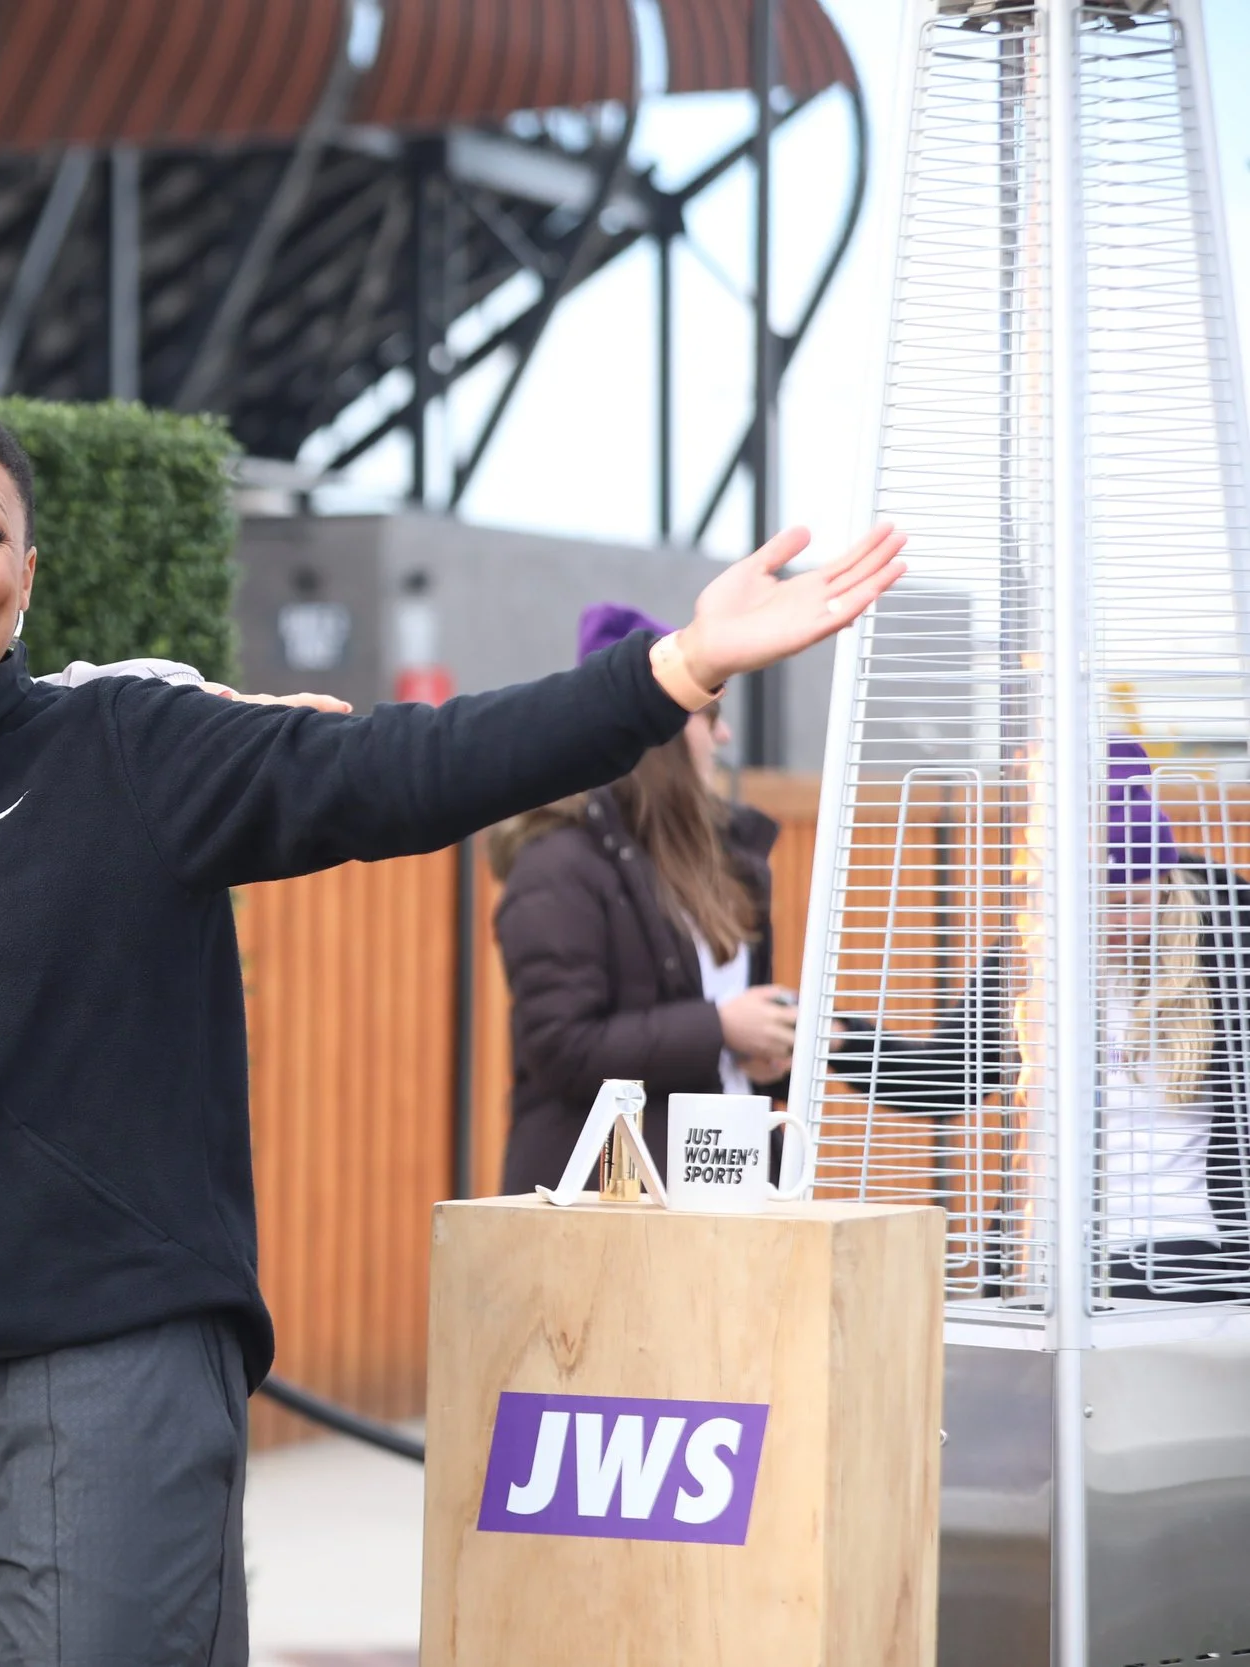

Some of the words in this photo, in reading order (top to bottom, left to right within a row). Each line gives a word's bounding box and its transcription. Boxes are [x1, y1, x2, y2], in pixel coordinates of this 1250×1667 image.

[684, 1128, 722, 1145] JUST
[684, 1147, 759, 1166] WOMEN'S
[683, 1166, 743, 1184] SPORTS
[505, 1410, 743, 1525] JWS
